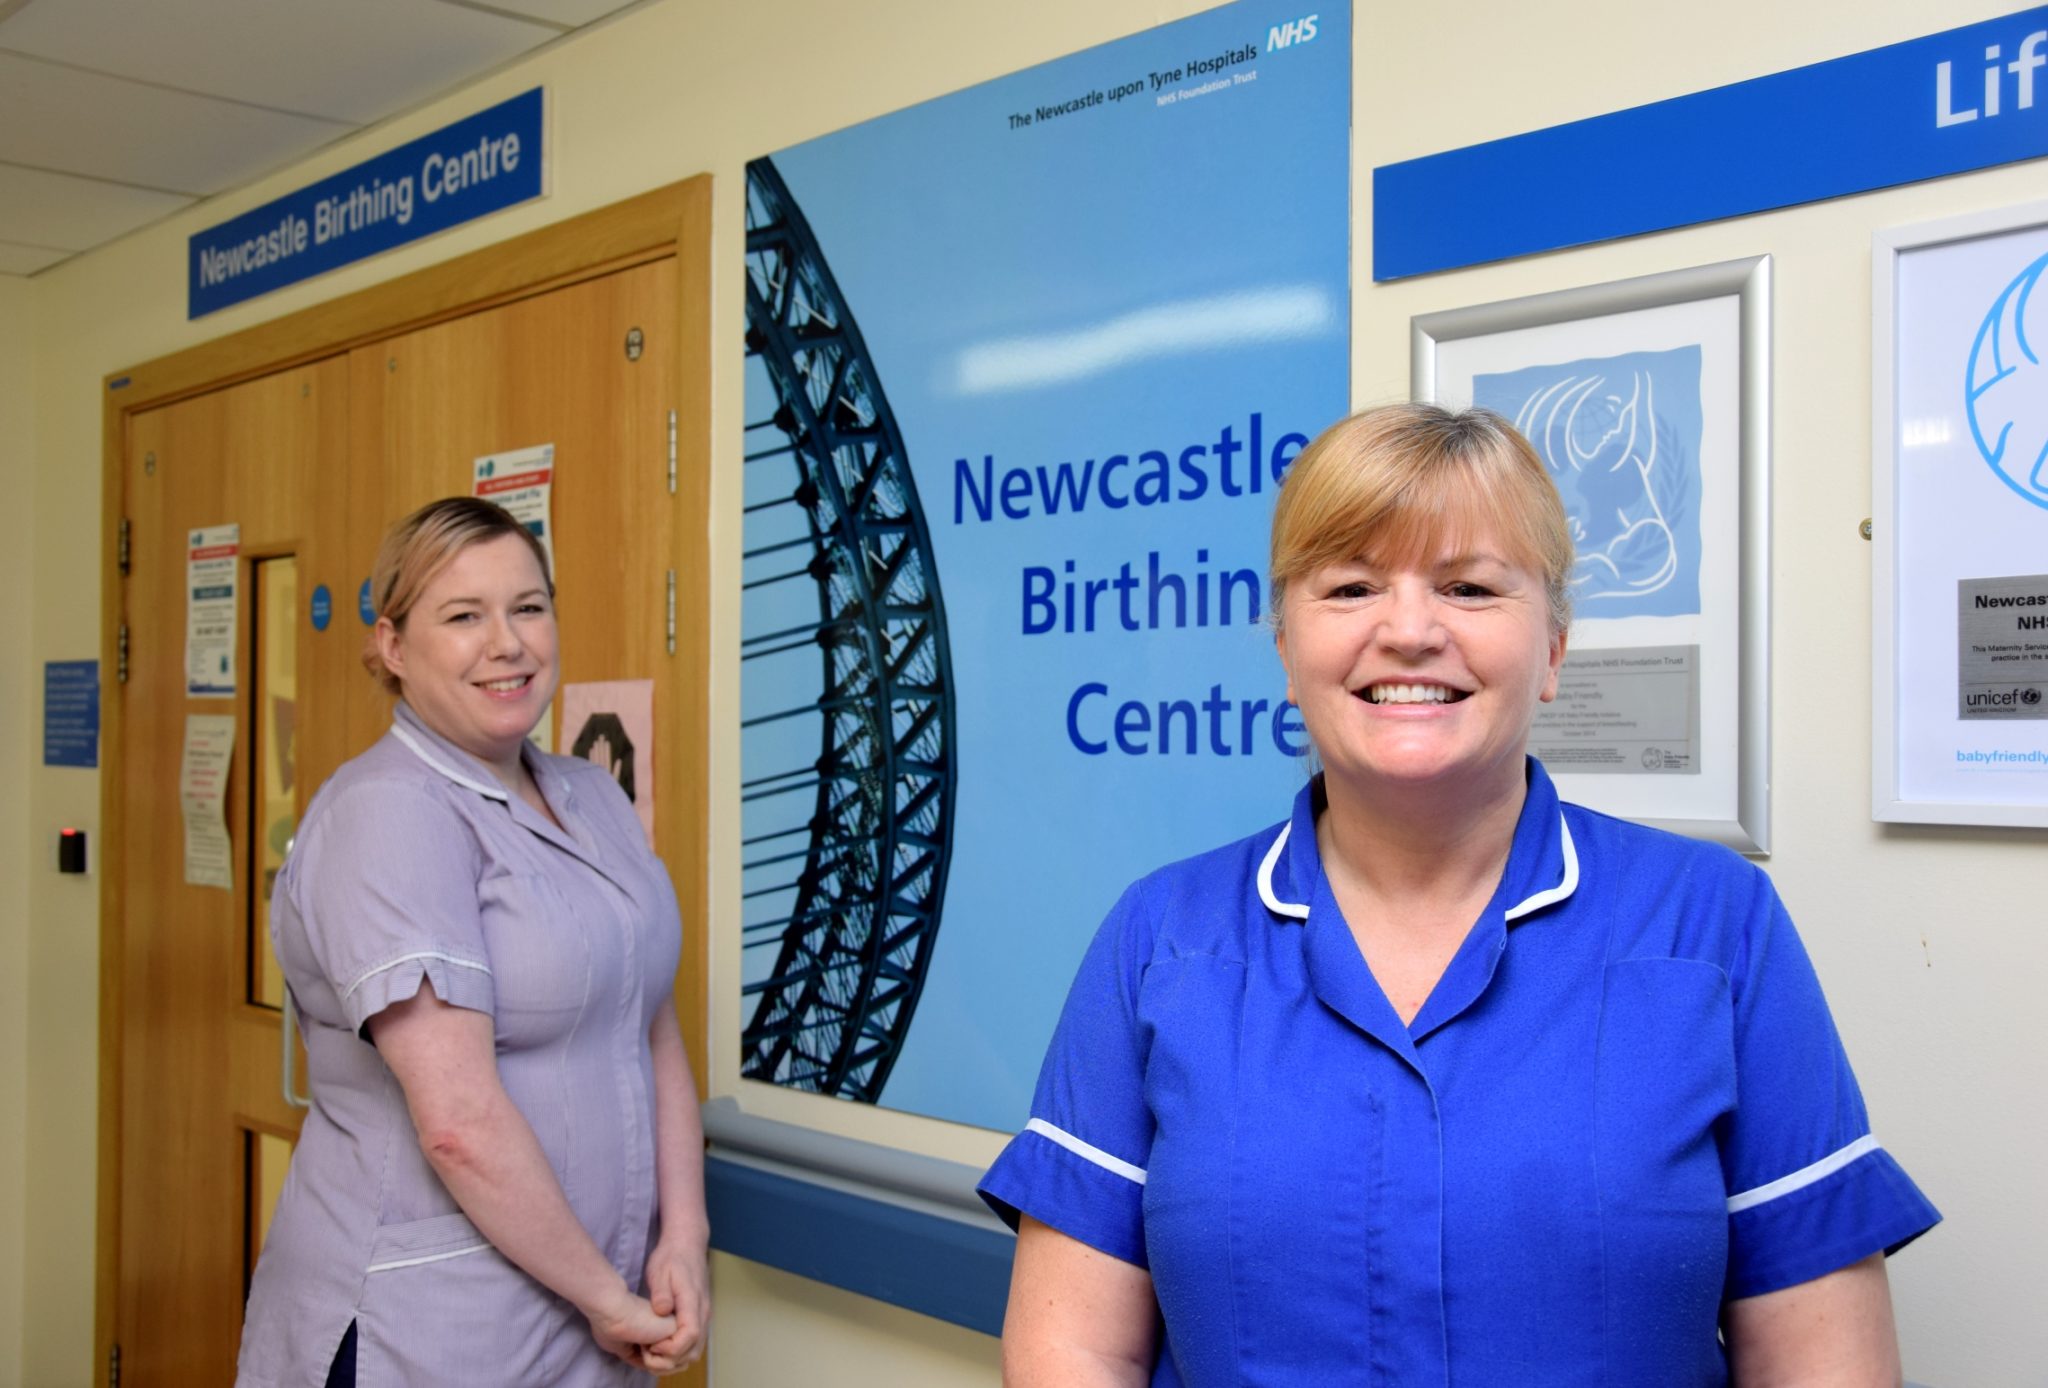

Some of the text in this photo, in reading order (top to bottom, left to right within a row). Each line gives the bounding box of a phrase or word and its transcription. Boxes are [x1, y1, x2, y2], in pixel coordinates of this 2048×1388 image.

[1267, 14, 1318, 52] NHS
[1008, 44, 1258, 130] The Newcastle upon Tyne Hospitals
[1156, 69, 1257, 107] NHS Foundation Trust
[1936, 30, 2047, 129] Lif
[200, 132, 520, 288] Newcastle Birthing Centre
[1022, 549, 1276, 636] Birthin
[1975, 595, 2048, 609] Newcas
[1664, 656, 1684, 666] Trust
[1988, 644, 2022, 653] Maternity
[1966, 688, 2019, 706] unicef
[1066, 682, 1311, 757] Centre
[1956, 750, 2048, 765] babyfriendly
